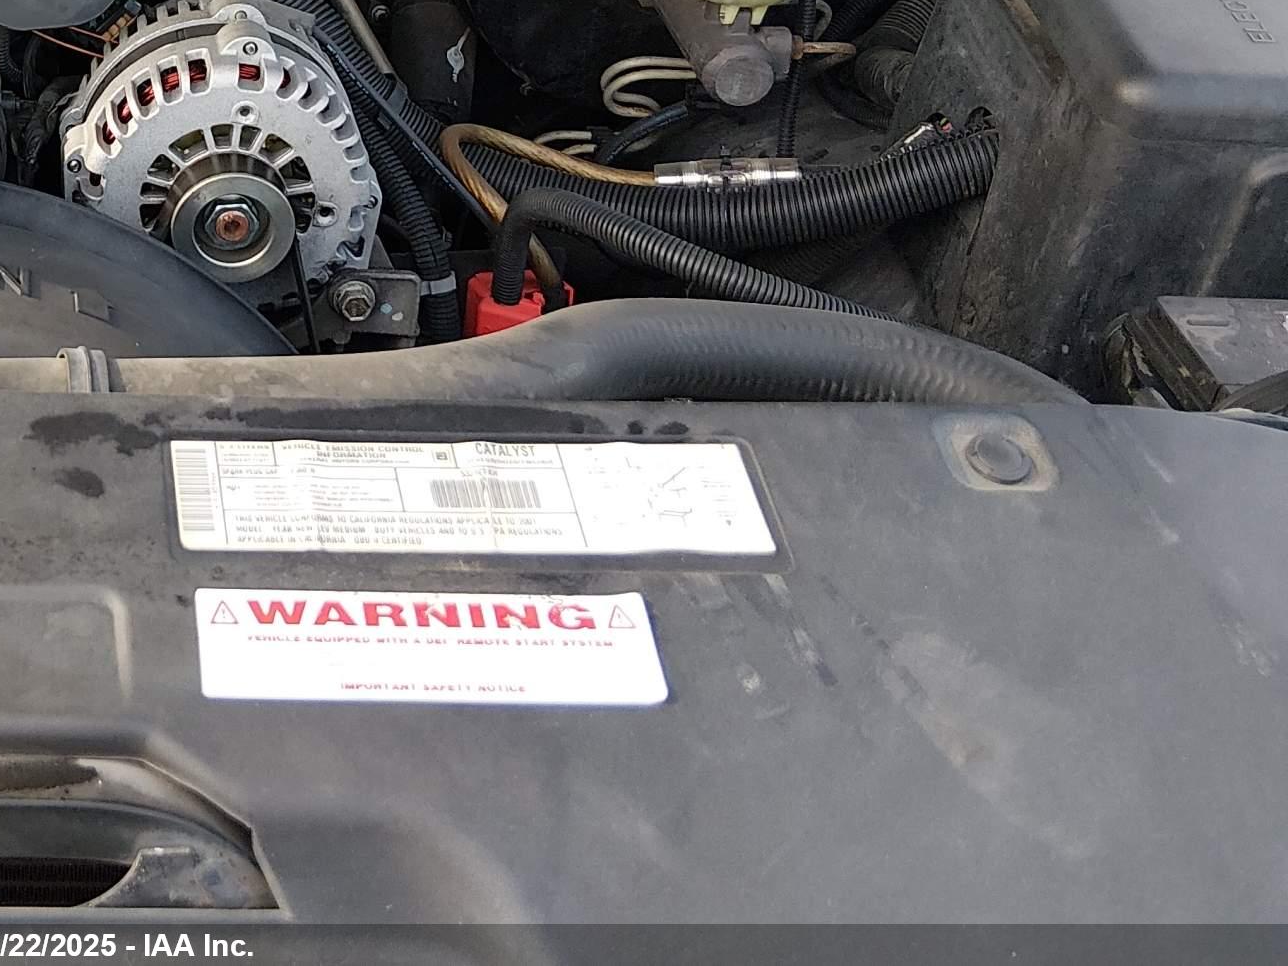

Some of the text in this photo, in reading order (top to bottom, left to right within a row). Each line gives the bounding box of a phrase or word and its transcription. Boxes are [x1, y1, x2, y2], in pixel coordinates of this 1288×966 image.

[475, 442, 536, 457] CATALYST
[456, 517, 503, 525] APPLICALE
[248, 600, 597, 631] WARNING
